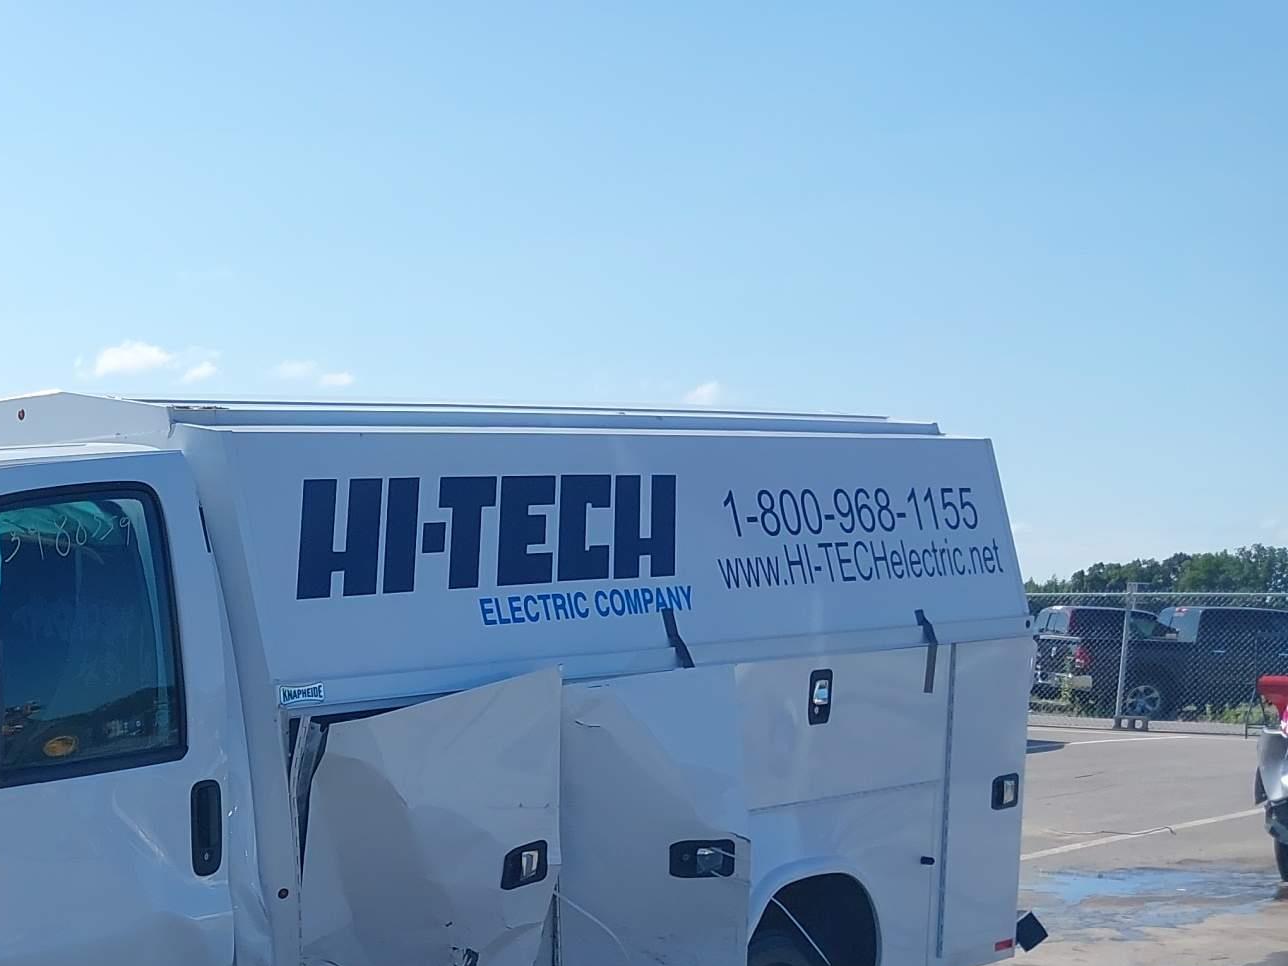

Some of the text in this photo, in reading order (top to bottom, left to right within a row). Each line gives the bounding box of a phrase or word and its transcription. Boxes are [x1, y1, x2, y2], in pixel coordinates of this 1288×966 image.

[296, 474, 677, 599] HI-TECH
[723, 487, 978, 537] 1-800-968-1155
[717, 538, 1004, 589] www.HI-TECHelectric.net
[479, 585, 692, 626] ELECTRIC COMPANY
[281, 685, 323, 701] KNAPHEIDE
